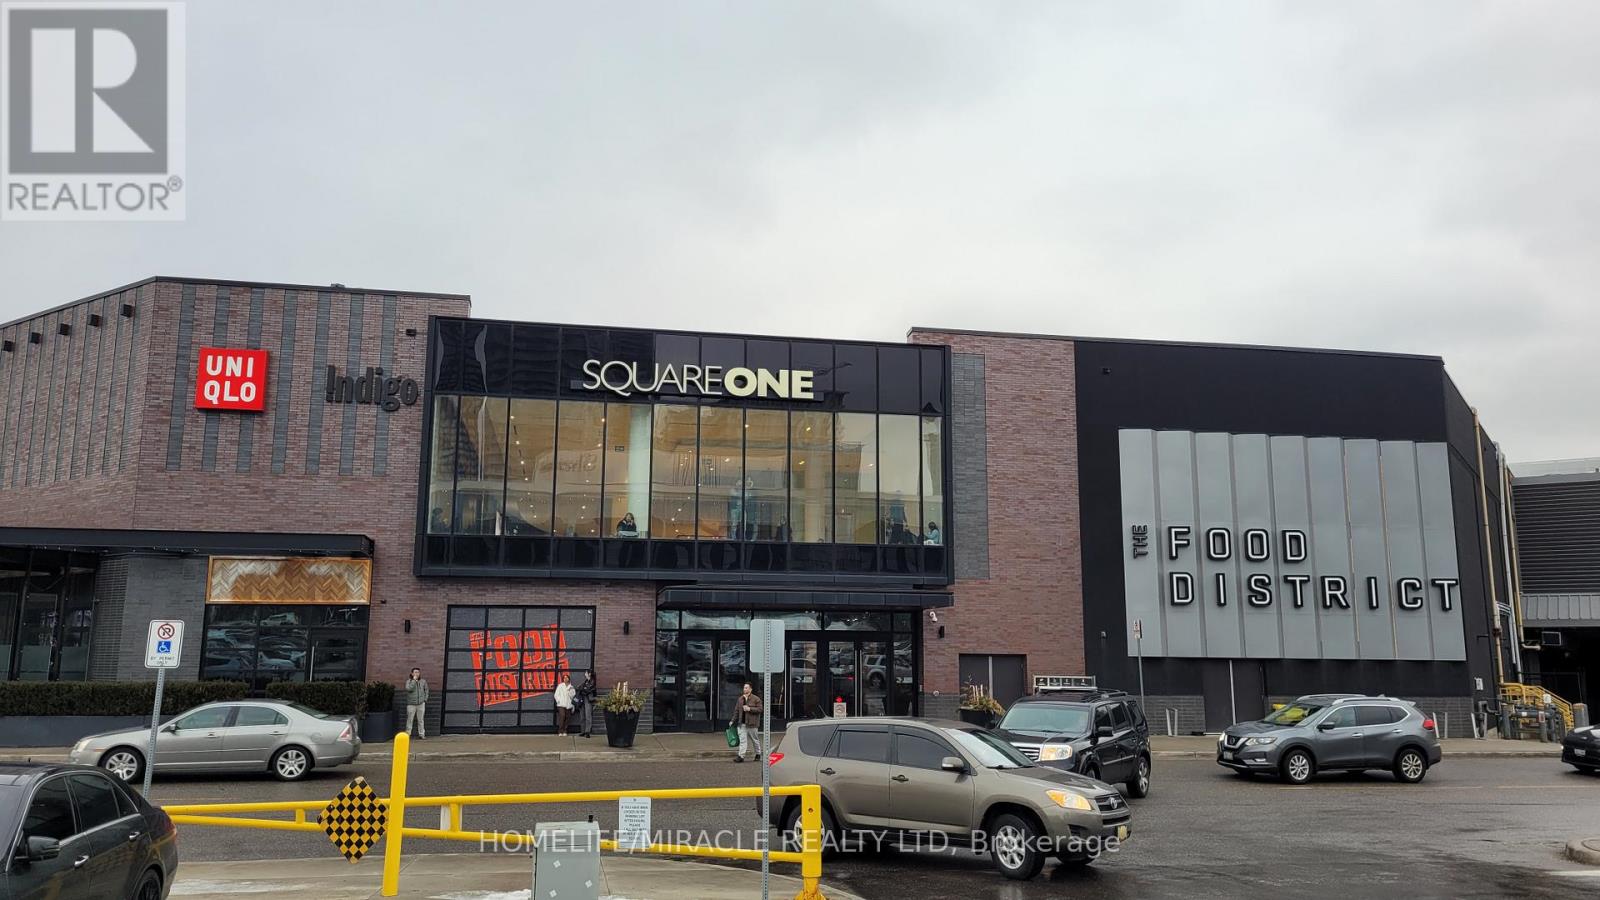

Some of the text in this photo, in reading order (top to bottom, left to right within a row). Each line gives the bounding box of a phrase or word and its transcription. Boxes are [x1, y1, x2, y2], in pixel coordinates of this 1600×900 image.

[205, 354, 255, 378] UNI
[203, 380, 257, 405] QLO
[325, 364, 419, 413] Indigo
[1132, 524, 1149, 560] THE
[1167, 525, 1308, 563] FOOD
[1168, 571, 1459, 611] DISTRICT
